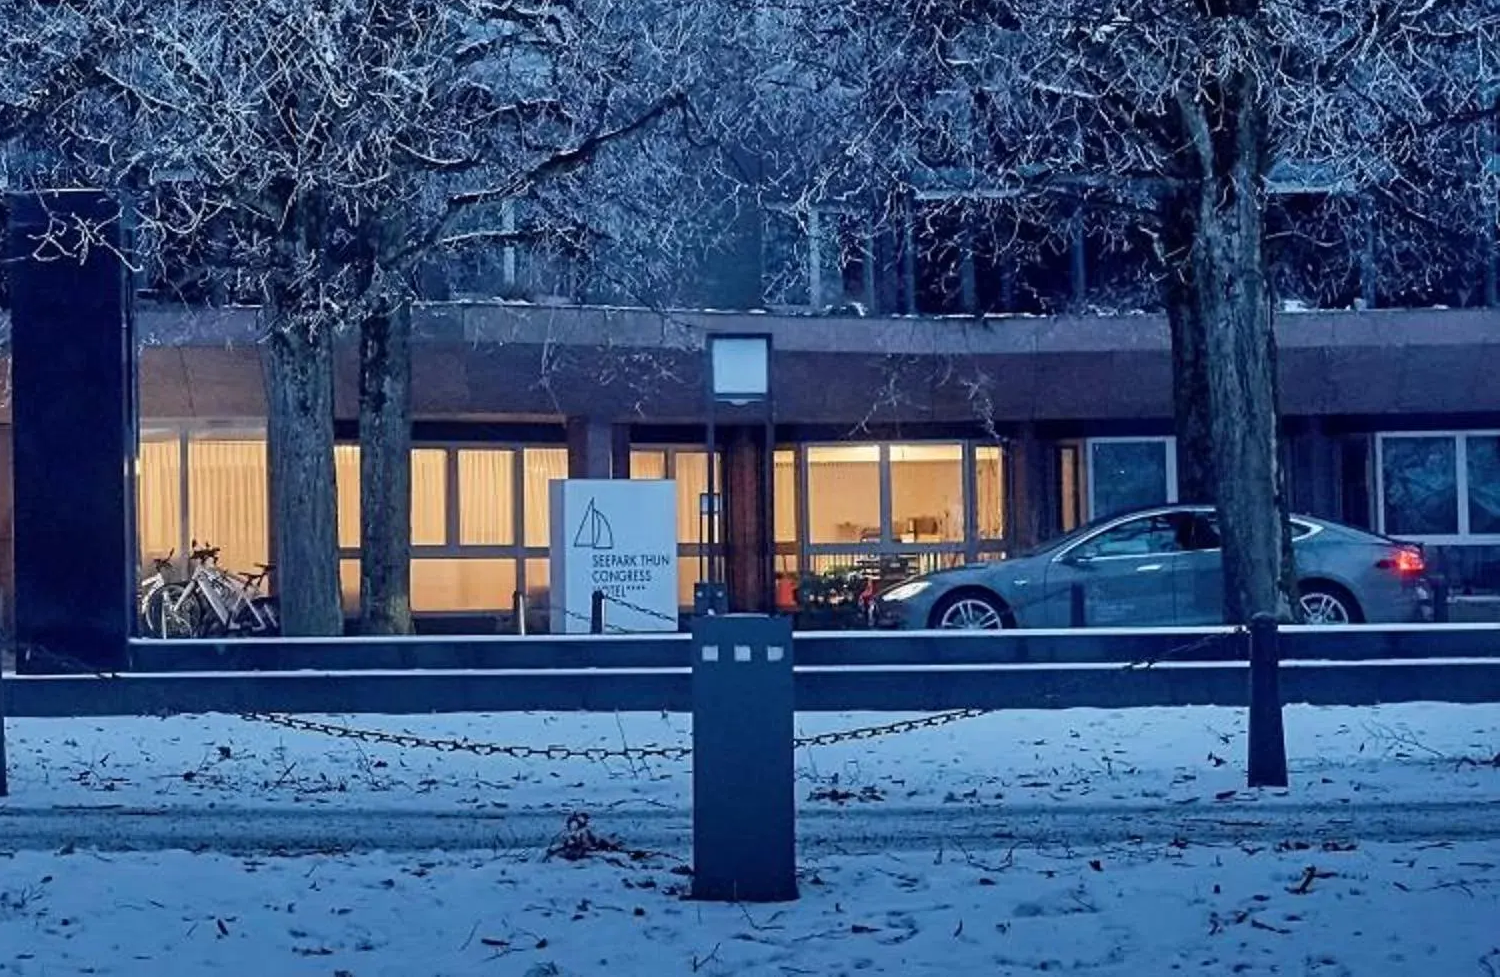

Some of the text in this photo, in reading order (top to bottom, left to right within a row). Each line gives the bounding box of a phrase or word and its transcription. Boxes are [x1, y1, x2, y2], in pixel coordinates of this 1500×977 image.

[592, 554, 669, 567] SEEPARK THUN
[592, 570, 652, 583] CONGRESS
